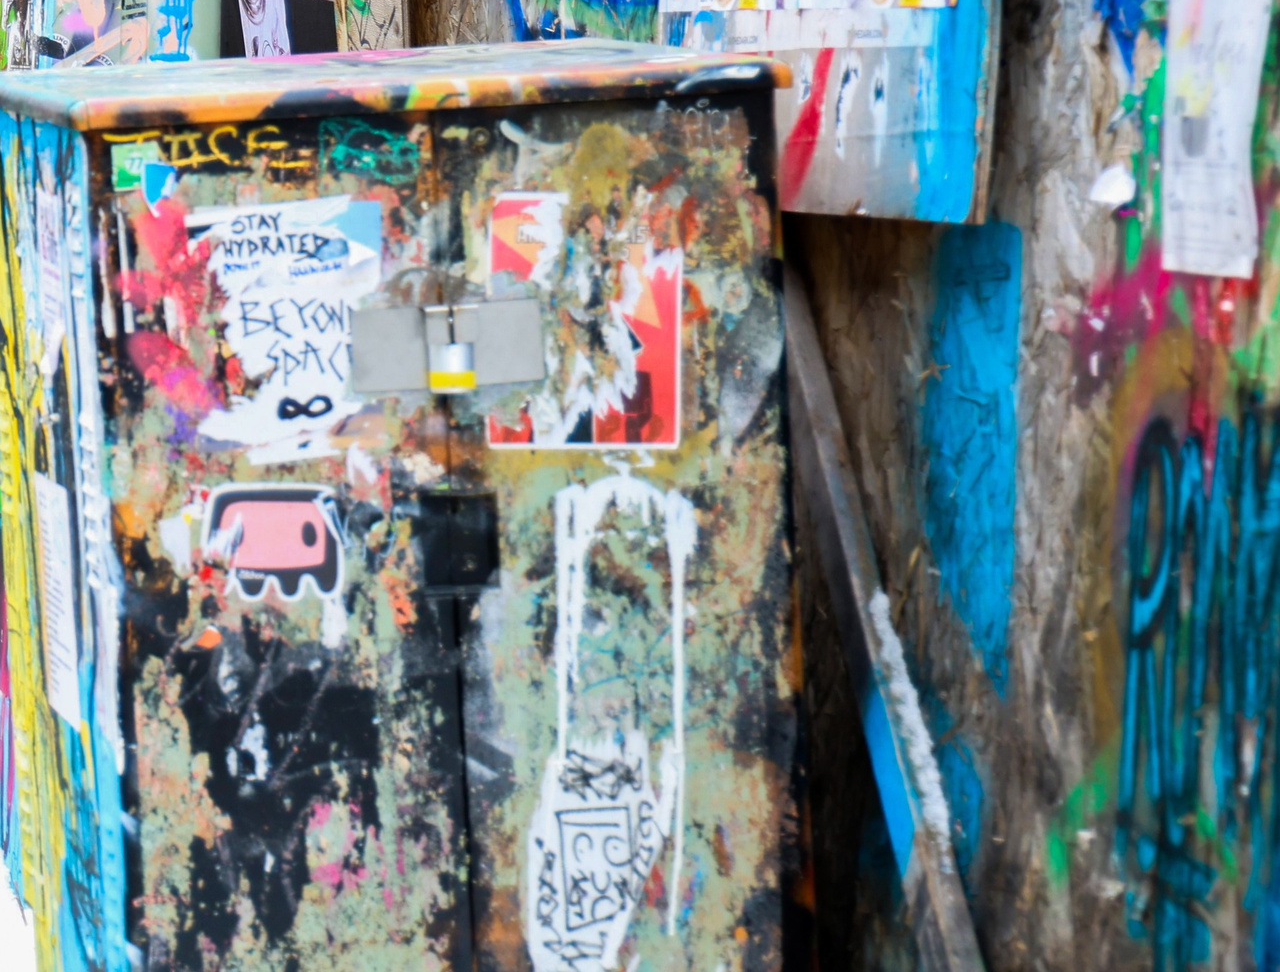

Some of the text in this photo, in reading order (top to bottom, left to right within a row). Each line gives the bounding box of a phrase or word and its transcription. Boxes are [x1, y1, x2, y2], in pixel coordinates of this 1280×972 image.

[231, 212, 281, 236] STAY
[239, 298, 352, 339] BEYON
[265, 339, 352, 387] SPAC
